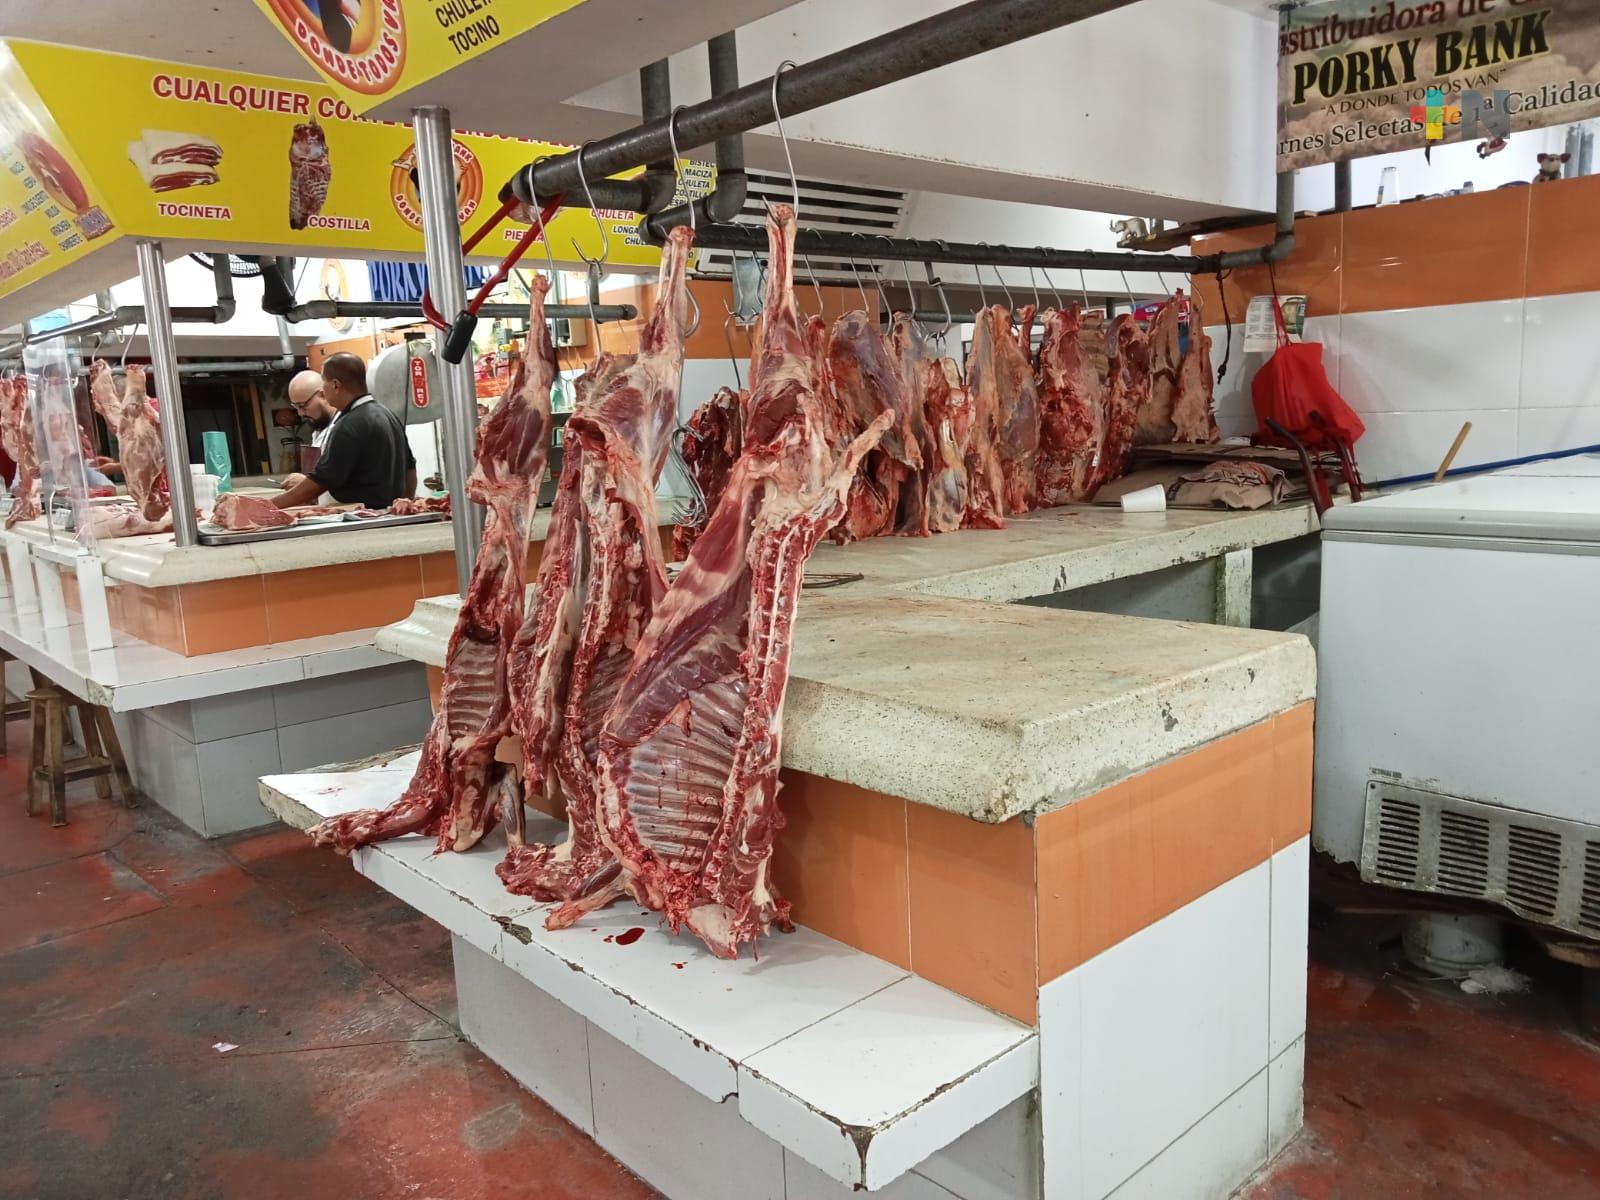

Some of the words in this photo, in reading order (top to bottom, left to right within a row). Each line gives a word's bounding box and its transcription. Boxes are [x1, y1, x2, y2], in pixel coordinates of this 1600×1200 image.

[448, 15, 500, 55] TOCINO
[1292, 38, 1422, 104] PORKY
[1434, 11, 1551, 76] BANK
[153, 75, 310, 115] CUALQUIER
[1340, 91, 1398, 113] DONDE
[1404, 79, 1461, 102] TODOS
[1330, 113, 1424, 146] Selectas
[684, 169, 712, 178] MACIZA
[158, 203, 231, 220] TOCINETA
[309, 216, 370, 231] COSTILLA
